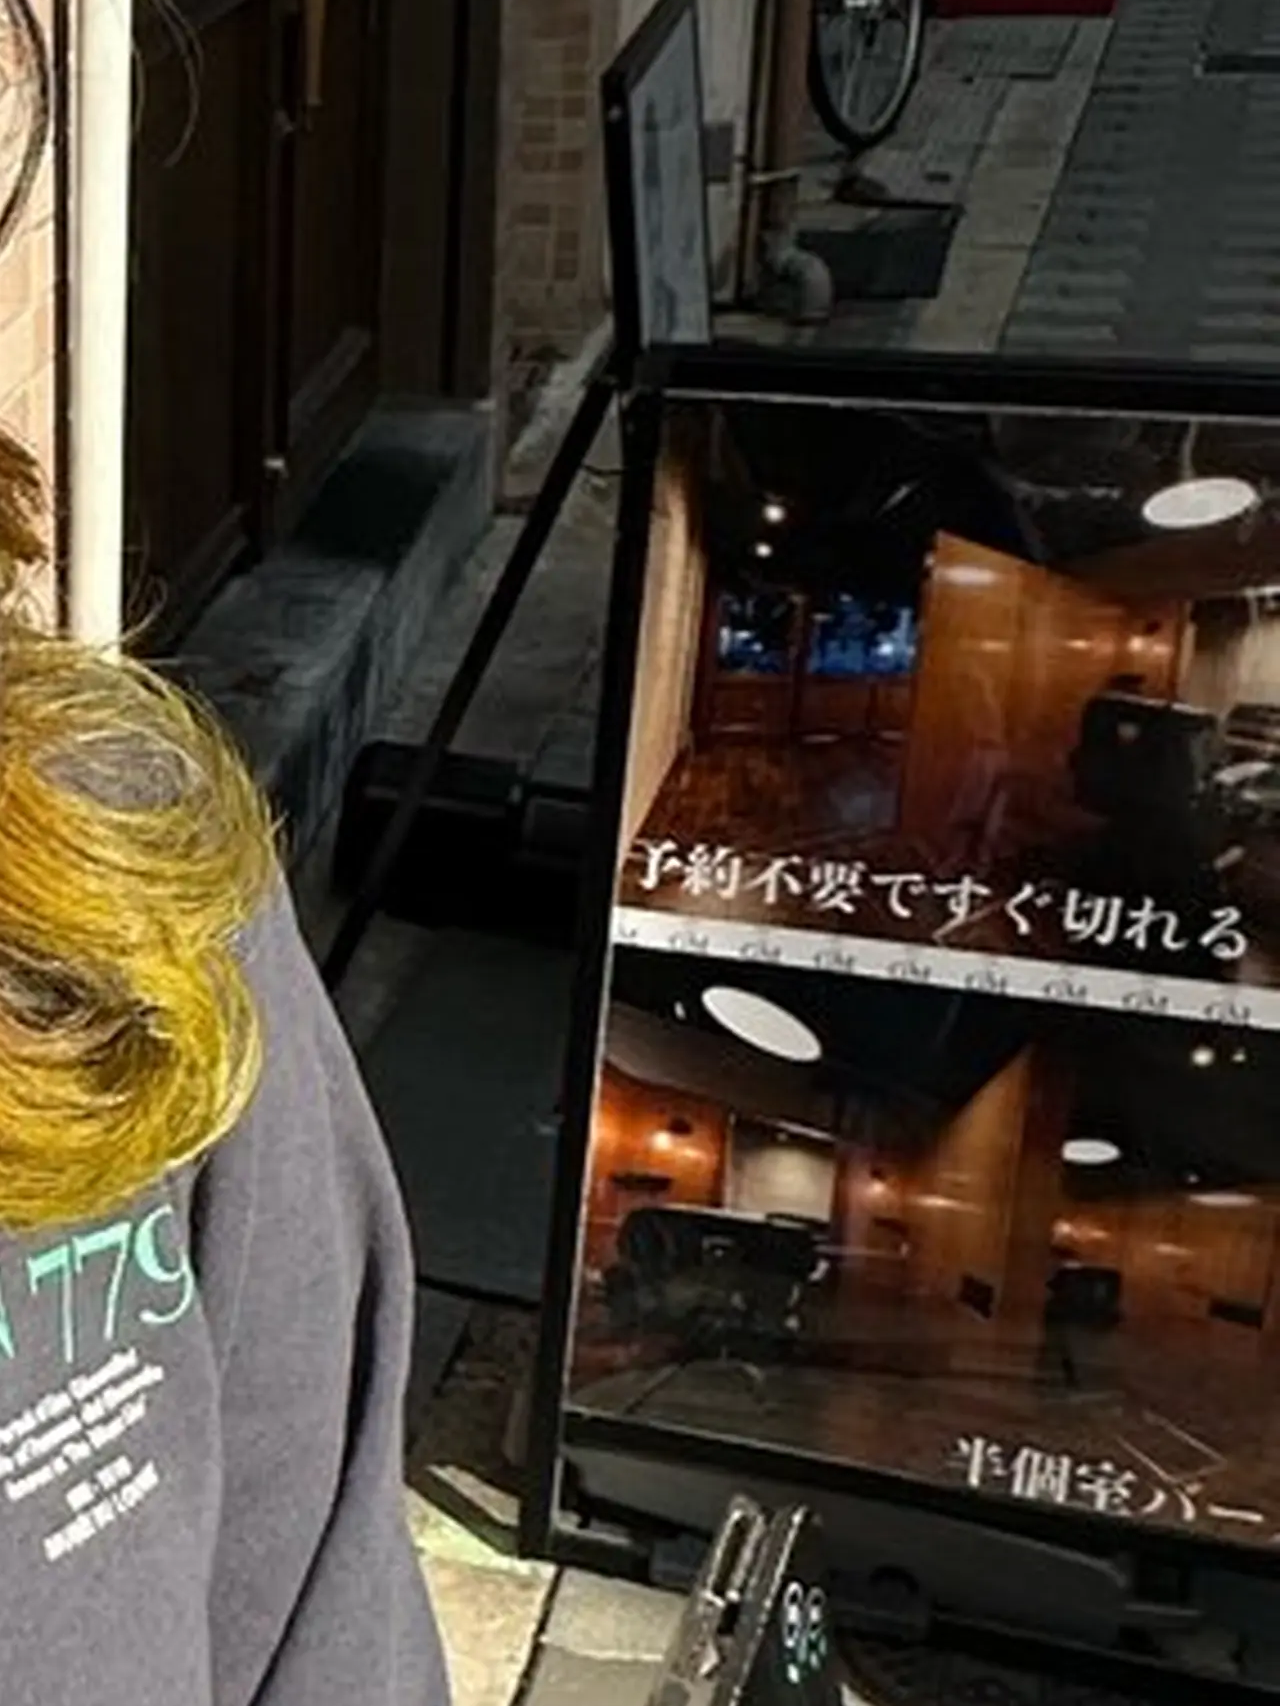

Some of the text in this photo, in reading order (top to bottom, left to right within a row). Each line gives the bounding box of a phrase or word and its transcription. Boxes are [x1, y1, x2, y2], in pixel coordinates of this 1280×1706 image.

[630, 838, 1248, 959] 予約不要ですぐ切れる
[26, 1204, 194, 1363] 779
[946, 1437, 1280, 1545] 半個室バー
